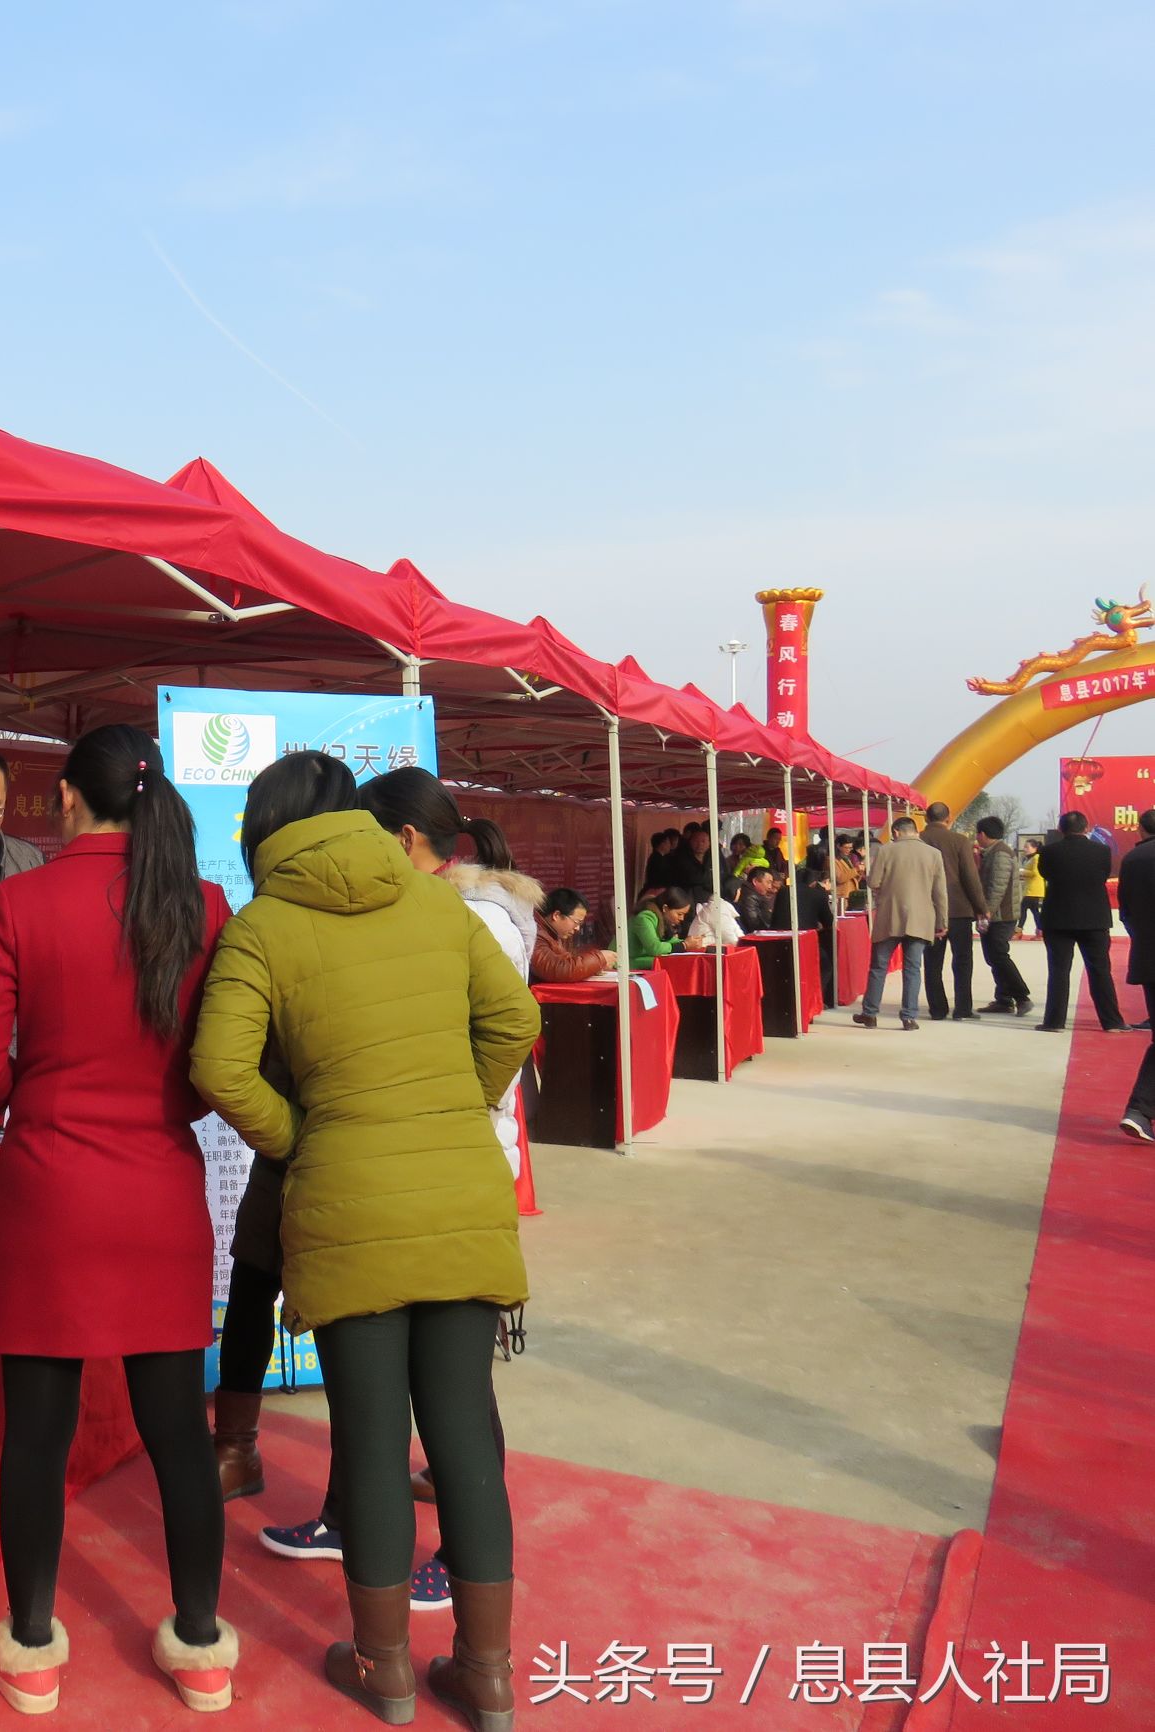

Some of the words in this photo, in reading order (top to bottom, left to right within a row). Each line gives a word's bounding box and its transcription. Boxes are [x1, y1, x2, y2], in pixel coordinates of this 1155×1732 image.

[777, 613, 799, 729] 春风行动
[183, 767, 216, 781] ECO
